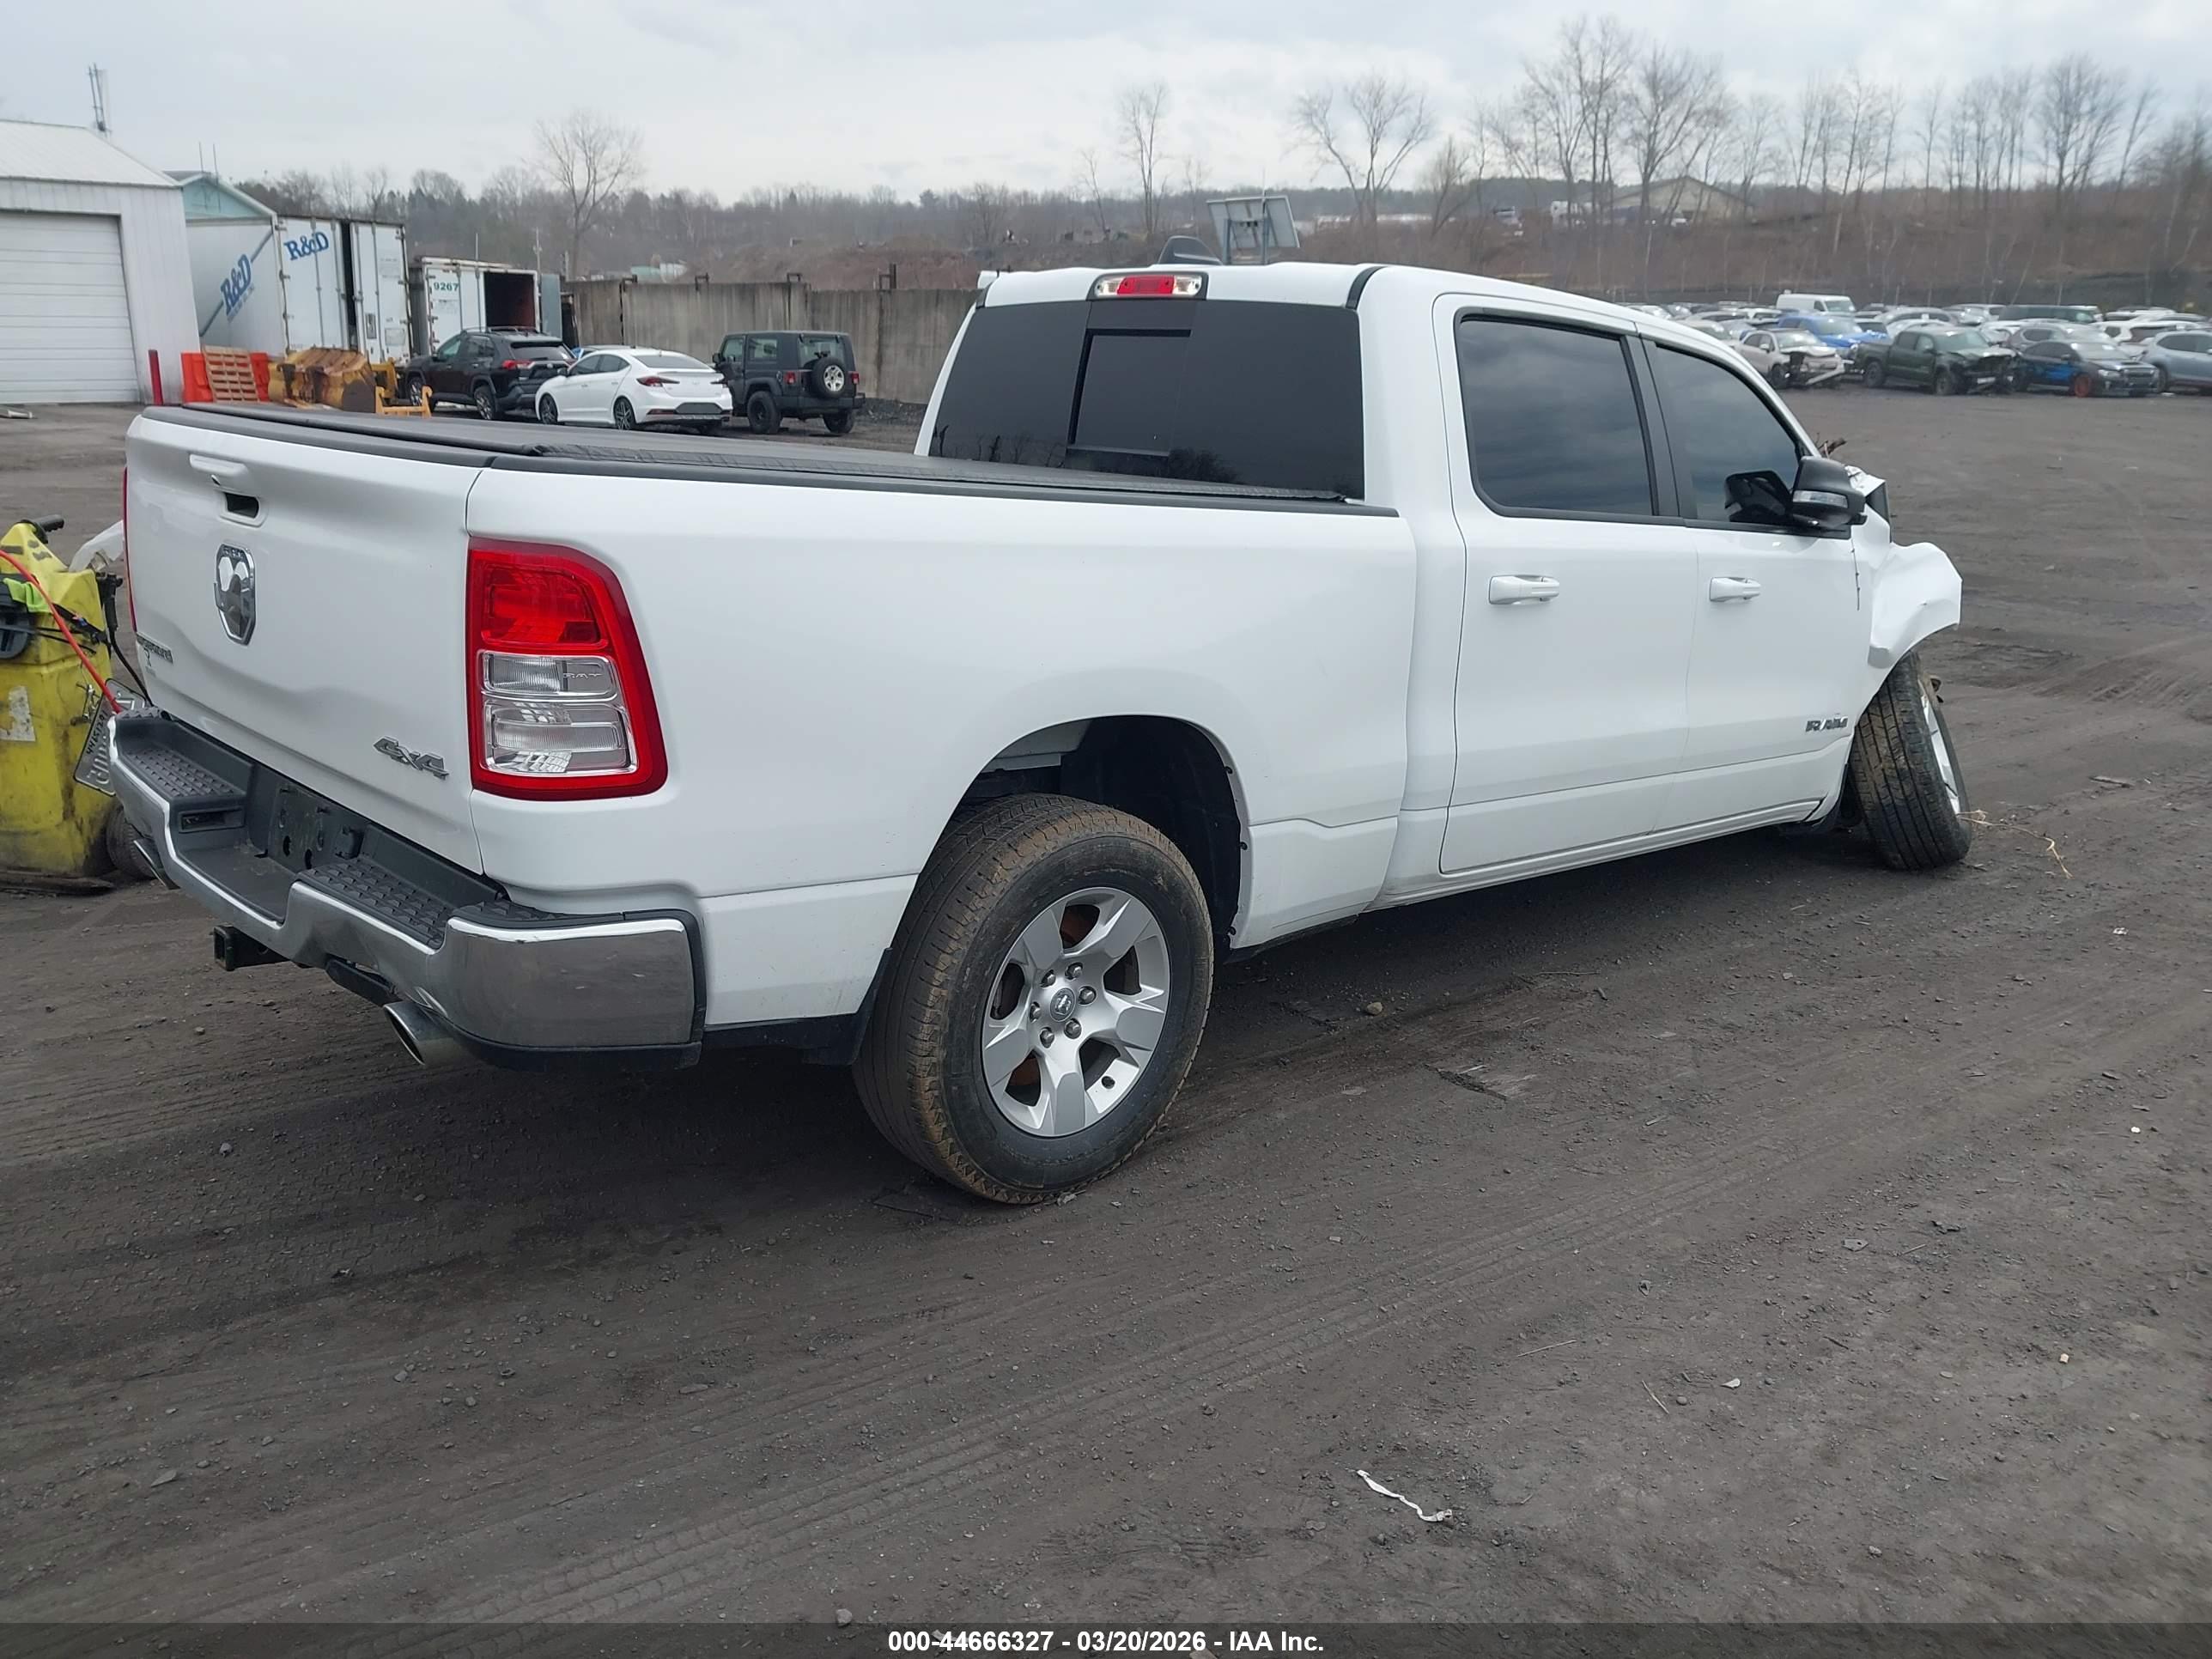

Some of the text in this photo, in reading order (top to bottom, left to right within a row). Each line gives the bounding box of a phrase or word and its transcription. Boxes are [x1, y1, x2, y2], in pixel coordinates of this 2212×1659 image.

[284, 231, 330, 261] R&D
[220, 254, 252, 316] R&D
[433, 281, 459, 292] 9267
[1805, 715, 1849, 732] RAM
